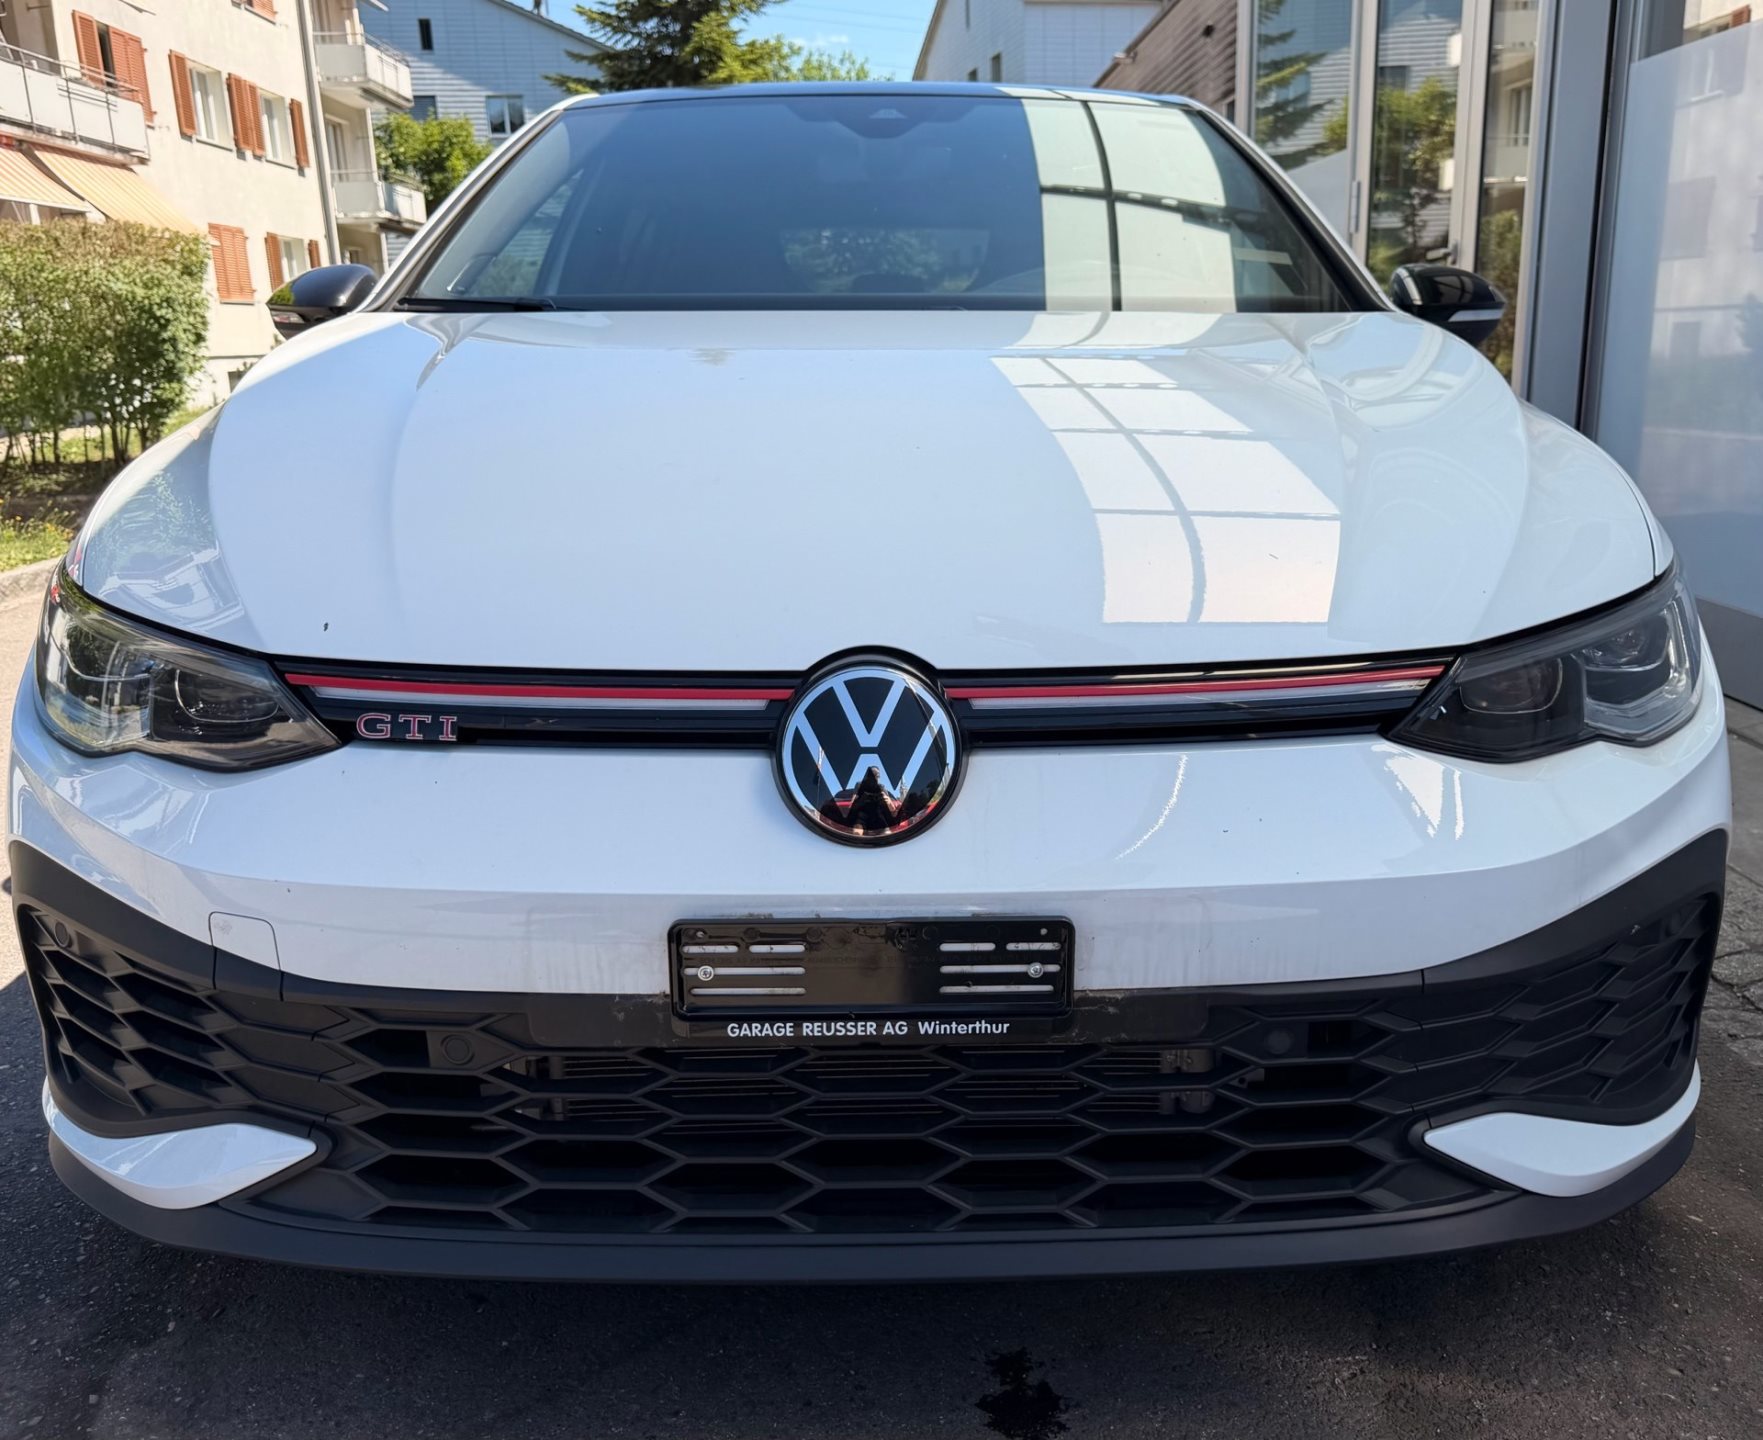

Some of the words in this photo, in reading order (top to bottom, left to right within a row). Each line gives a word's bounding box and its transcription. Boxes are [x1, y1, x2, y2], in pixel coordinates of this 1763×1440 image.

[356, 712, 458, 742] GTI
[788, 671, 951, 826] VW
[727, 1022, 795, 1037] GARAGE
[802, 1021, 877, 1036] REUSSER
[882, 1020, 909, 1035] AG
[917, 1019, 1010, 1034] Winterthur
